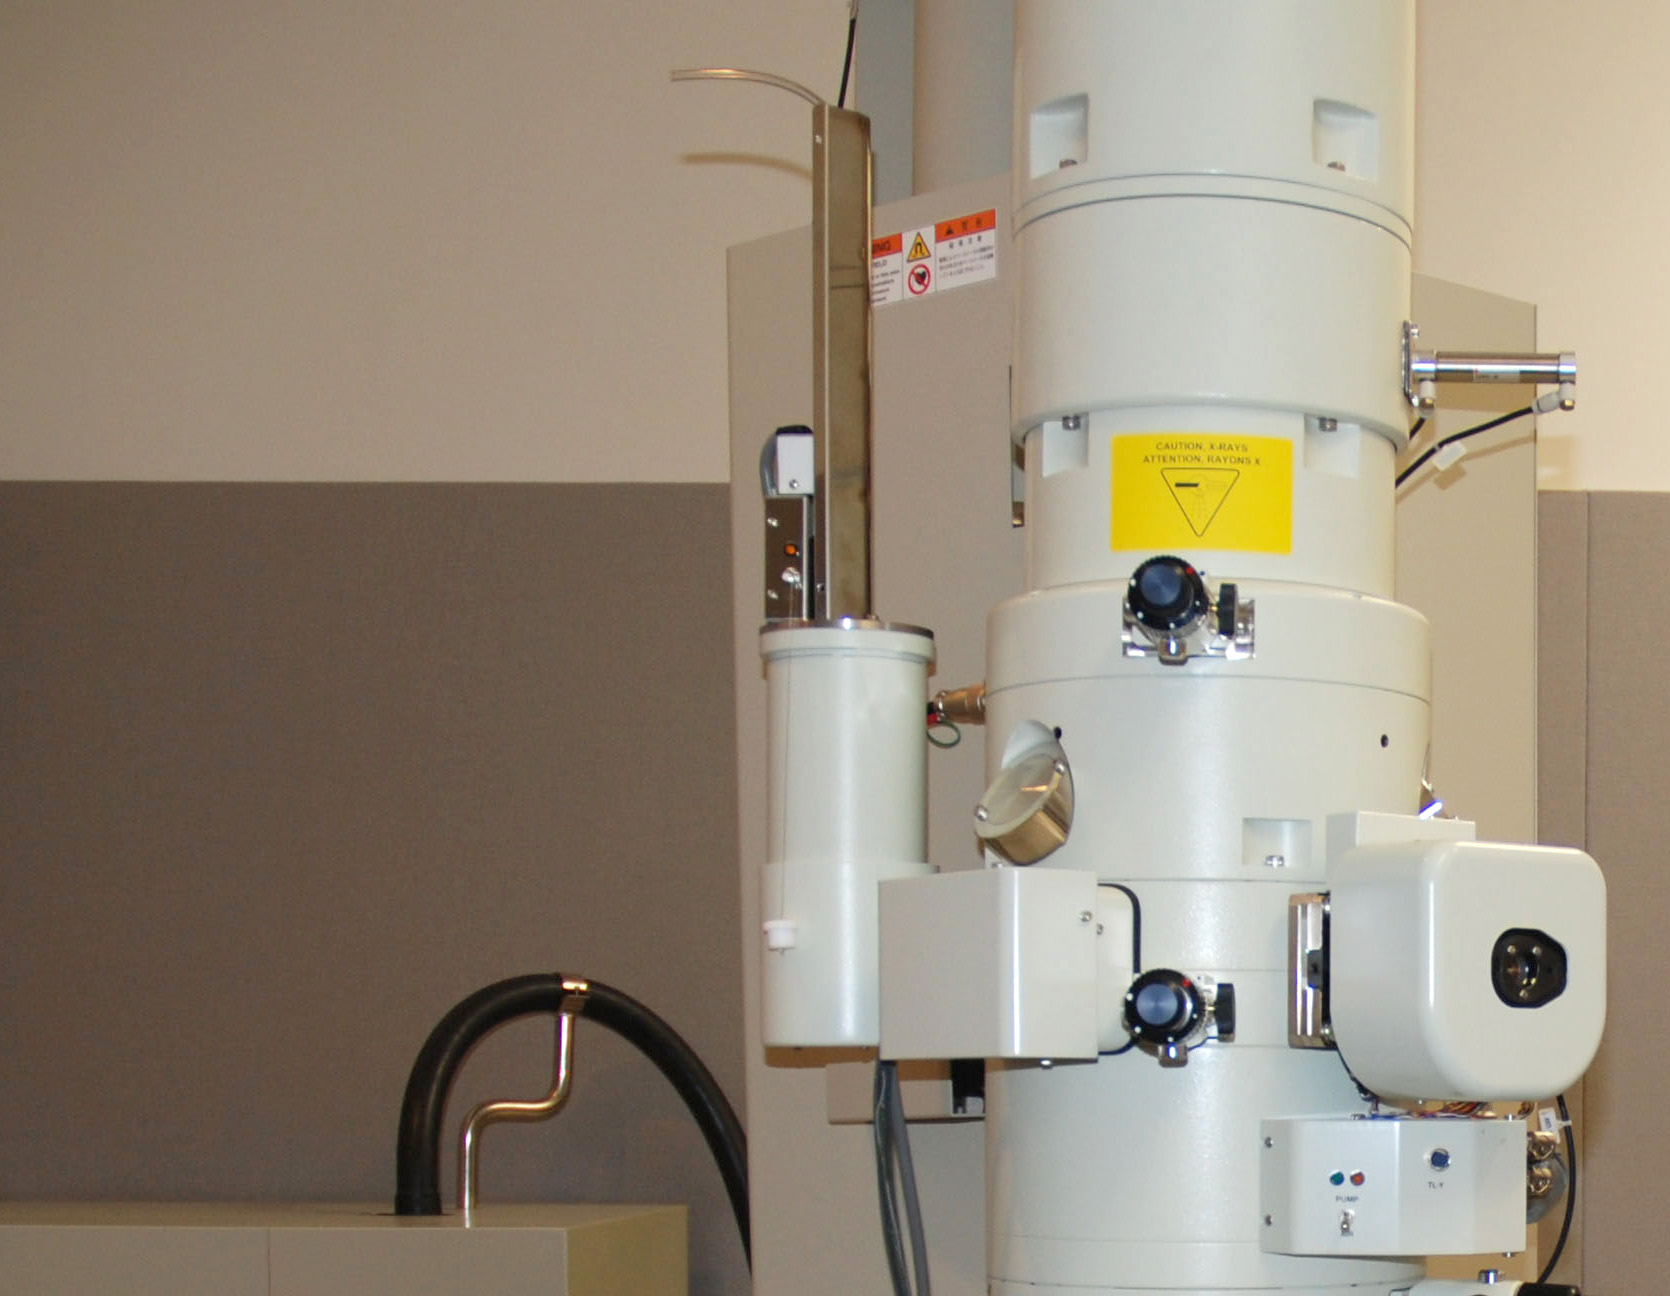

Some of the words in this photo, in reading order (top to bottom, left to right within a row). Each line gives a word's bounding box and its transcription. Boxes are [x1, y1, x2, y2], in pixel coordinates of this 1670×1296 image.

[1156, 442, 1206, 452] CAUTION,
[1209, 442, 1248, 452] X-RAYS
[1143, 454, 1204, 464] ATTENTION,
[1207, 455, 1251, 465] RAYONS
